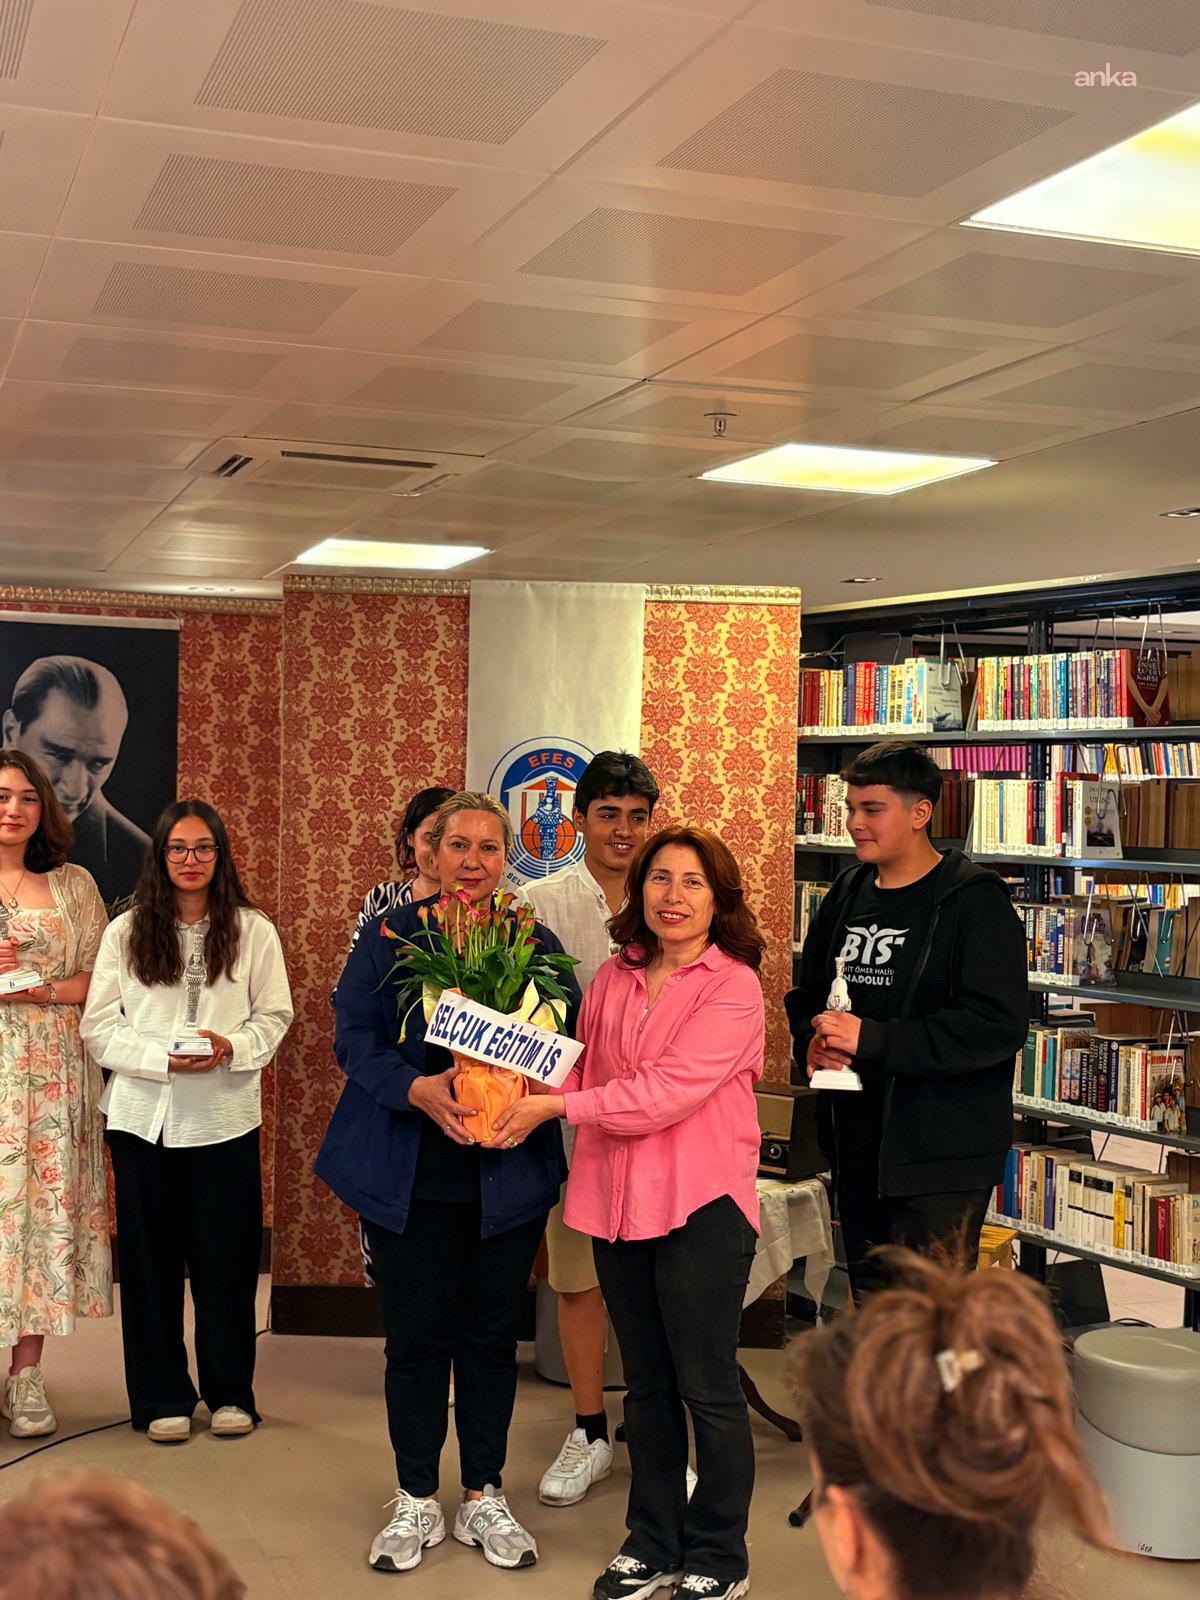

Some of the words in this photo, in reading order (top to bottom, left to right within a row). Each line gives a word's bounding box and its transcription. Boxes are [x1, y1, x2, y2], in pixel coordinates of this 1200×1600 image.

[527, 752, 576, 769] EFES
[506, 872, 527, 887] SEL
[855, 965, 874, 974] ÖMER
[844, 974, 884, 985] NADOLU
[430, 1003, 492, 1047] SELÇUK
[483, 1022, 545, 1070] EĞİTİM
[537, 1038, 562, 1081] İŞ
